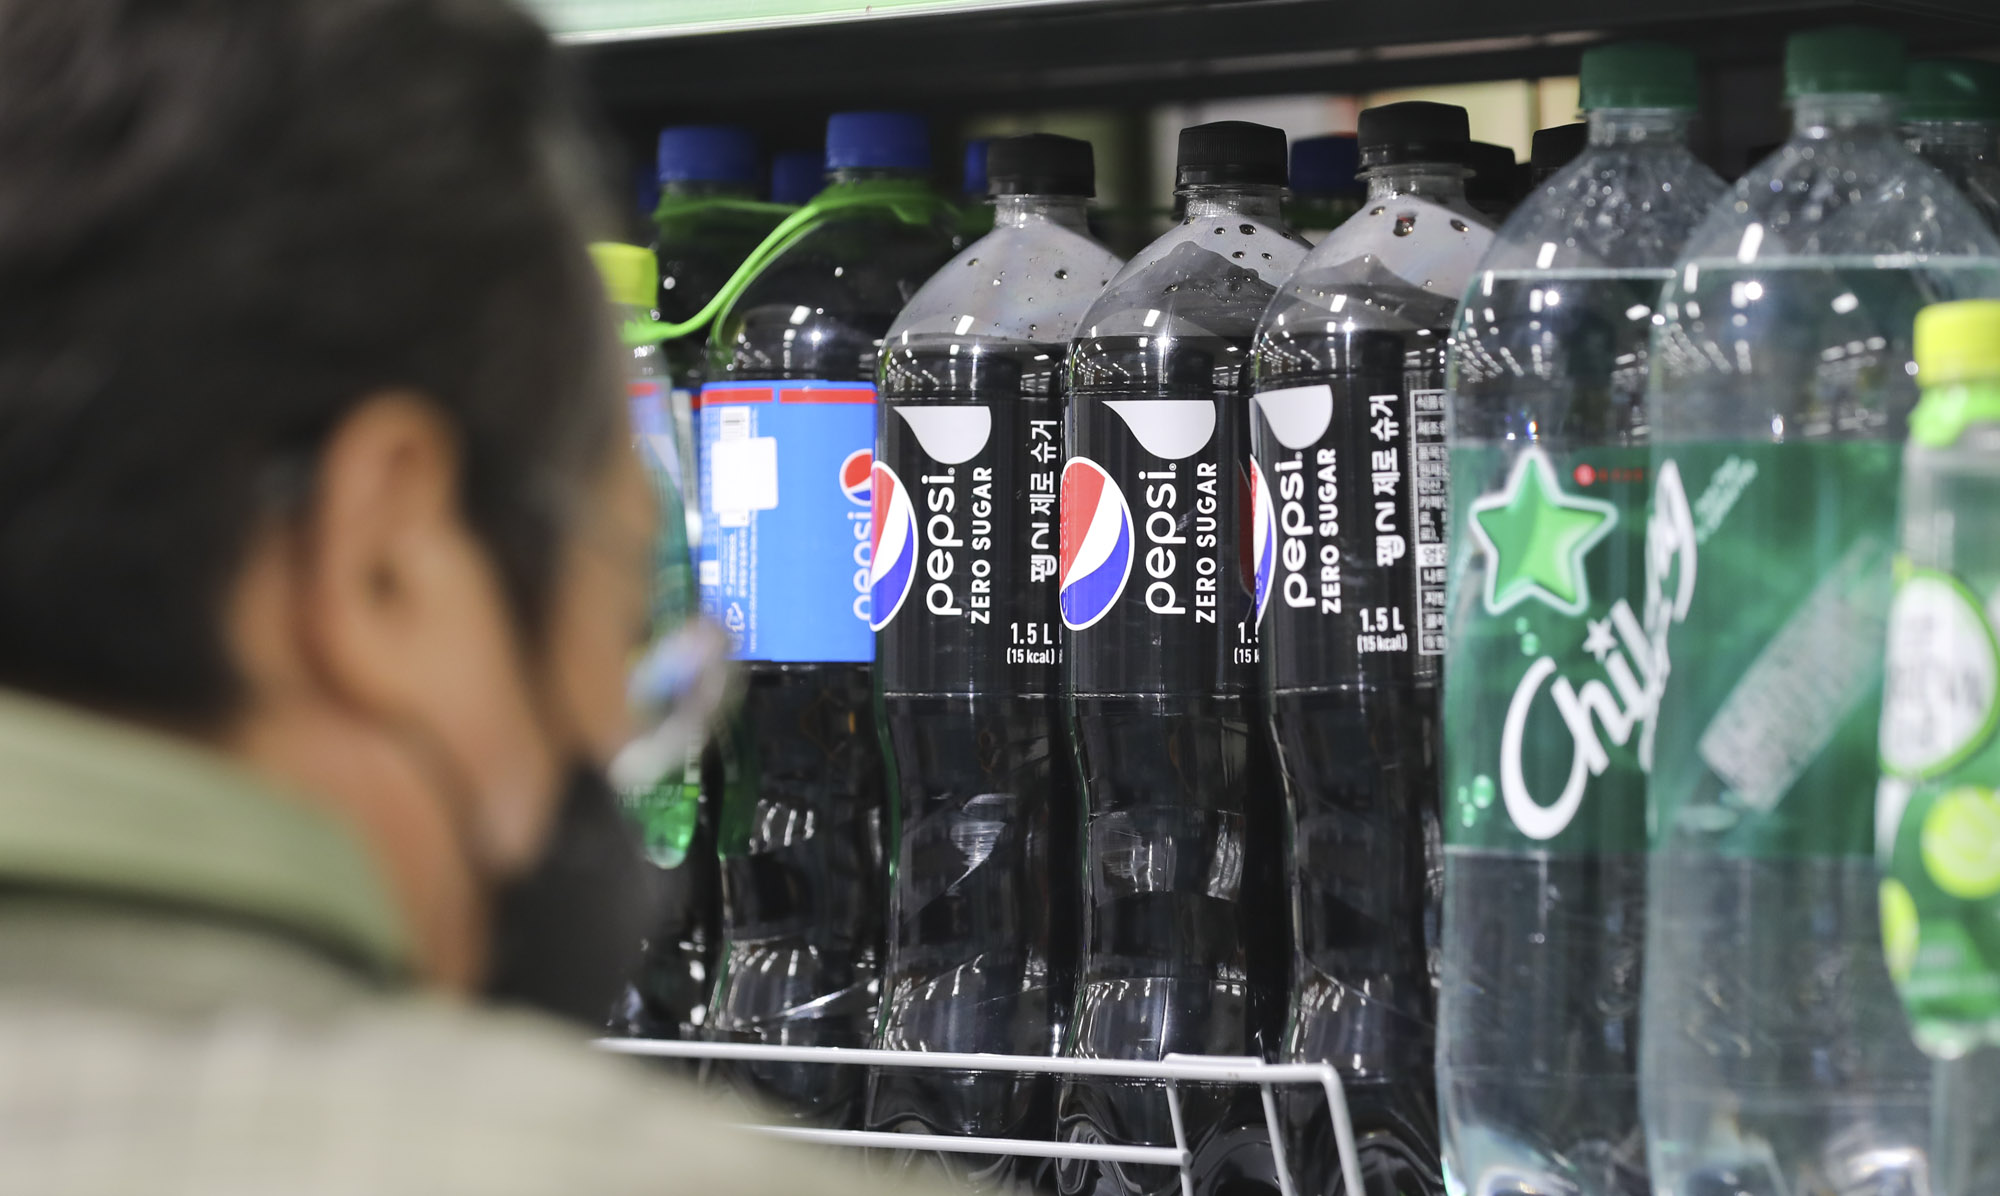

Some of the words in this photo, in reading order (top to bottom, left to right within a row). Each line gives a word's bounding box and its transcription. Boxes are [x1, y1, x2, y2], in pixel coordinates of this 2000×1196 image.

[1030, 420, 1058, 464] 슈거
[1368, 394, 1400, 442] 슈거
[1029, 471, 1057, 515] 제로
[1316, 448, 1339, 538] SUGAR
[1371, 447, 1401, 496] 제로
[971, 466, 993, 551] SUGAR
[1196, 462, 1218, 548] SUGAR
[921, 474, 964, 616] pepsi
[1138, 471, 1187, 615] pepsi
[1274, 460, 1316, 608] pepsi
[970, 559, 991, 625] ZERO
[1195, 558, 1217, 624] ZERO
[1319, 544, 1342, 615] ZERO
[1010, 622, 1038, 645] 1.5
[1043, 622, 1053, 645] L
[1357, 634, 1376, 654] (15
[1376, 632, 1408, 652] kcal)
[1359, 606, 1389, 632] 1.5
[1392, 606, 1405, 632] L
[1006, 647, 1025, 665] (15
[1026, 647, 1055, 665] kcal)
[1234, 647, 1252, 665] (15
